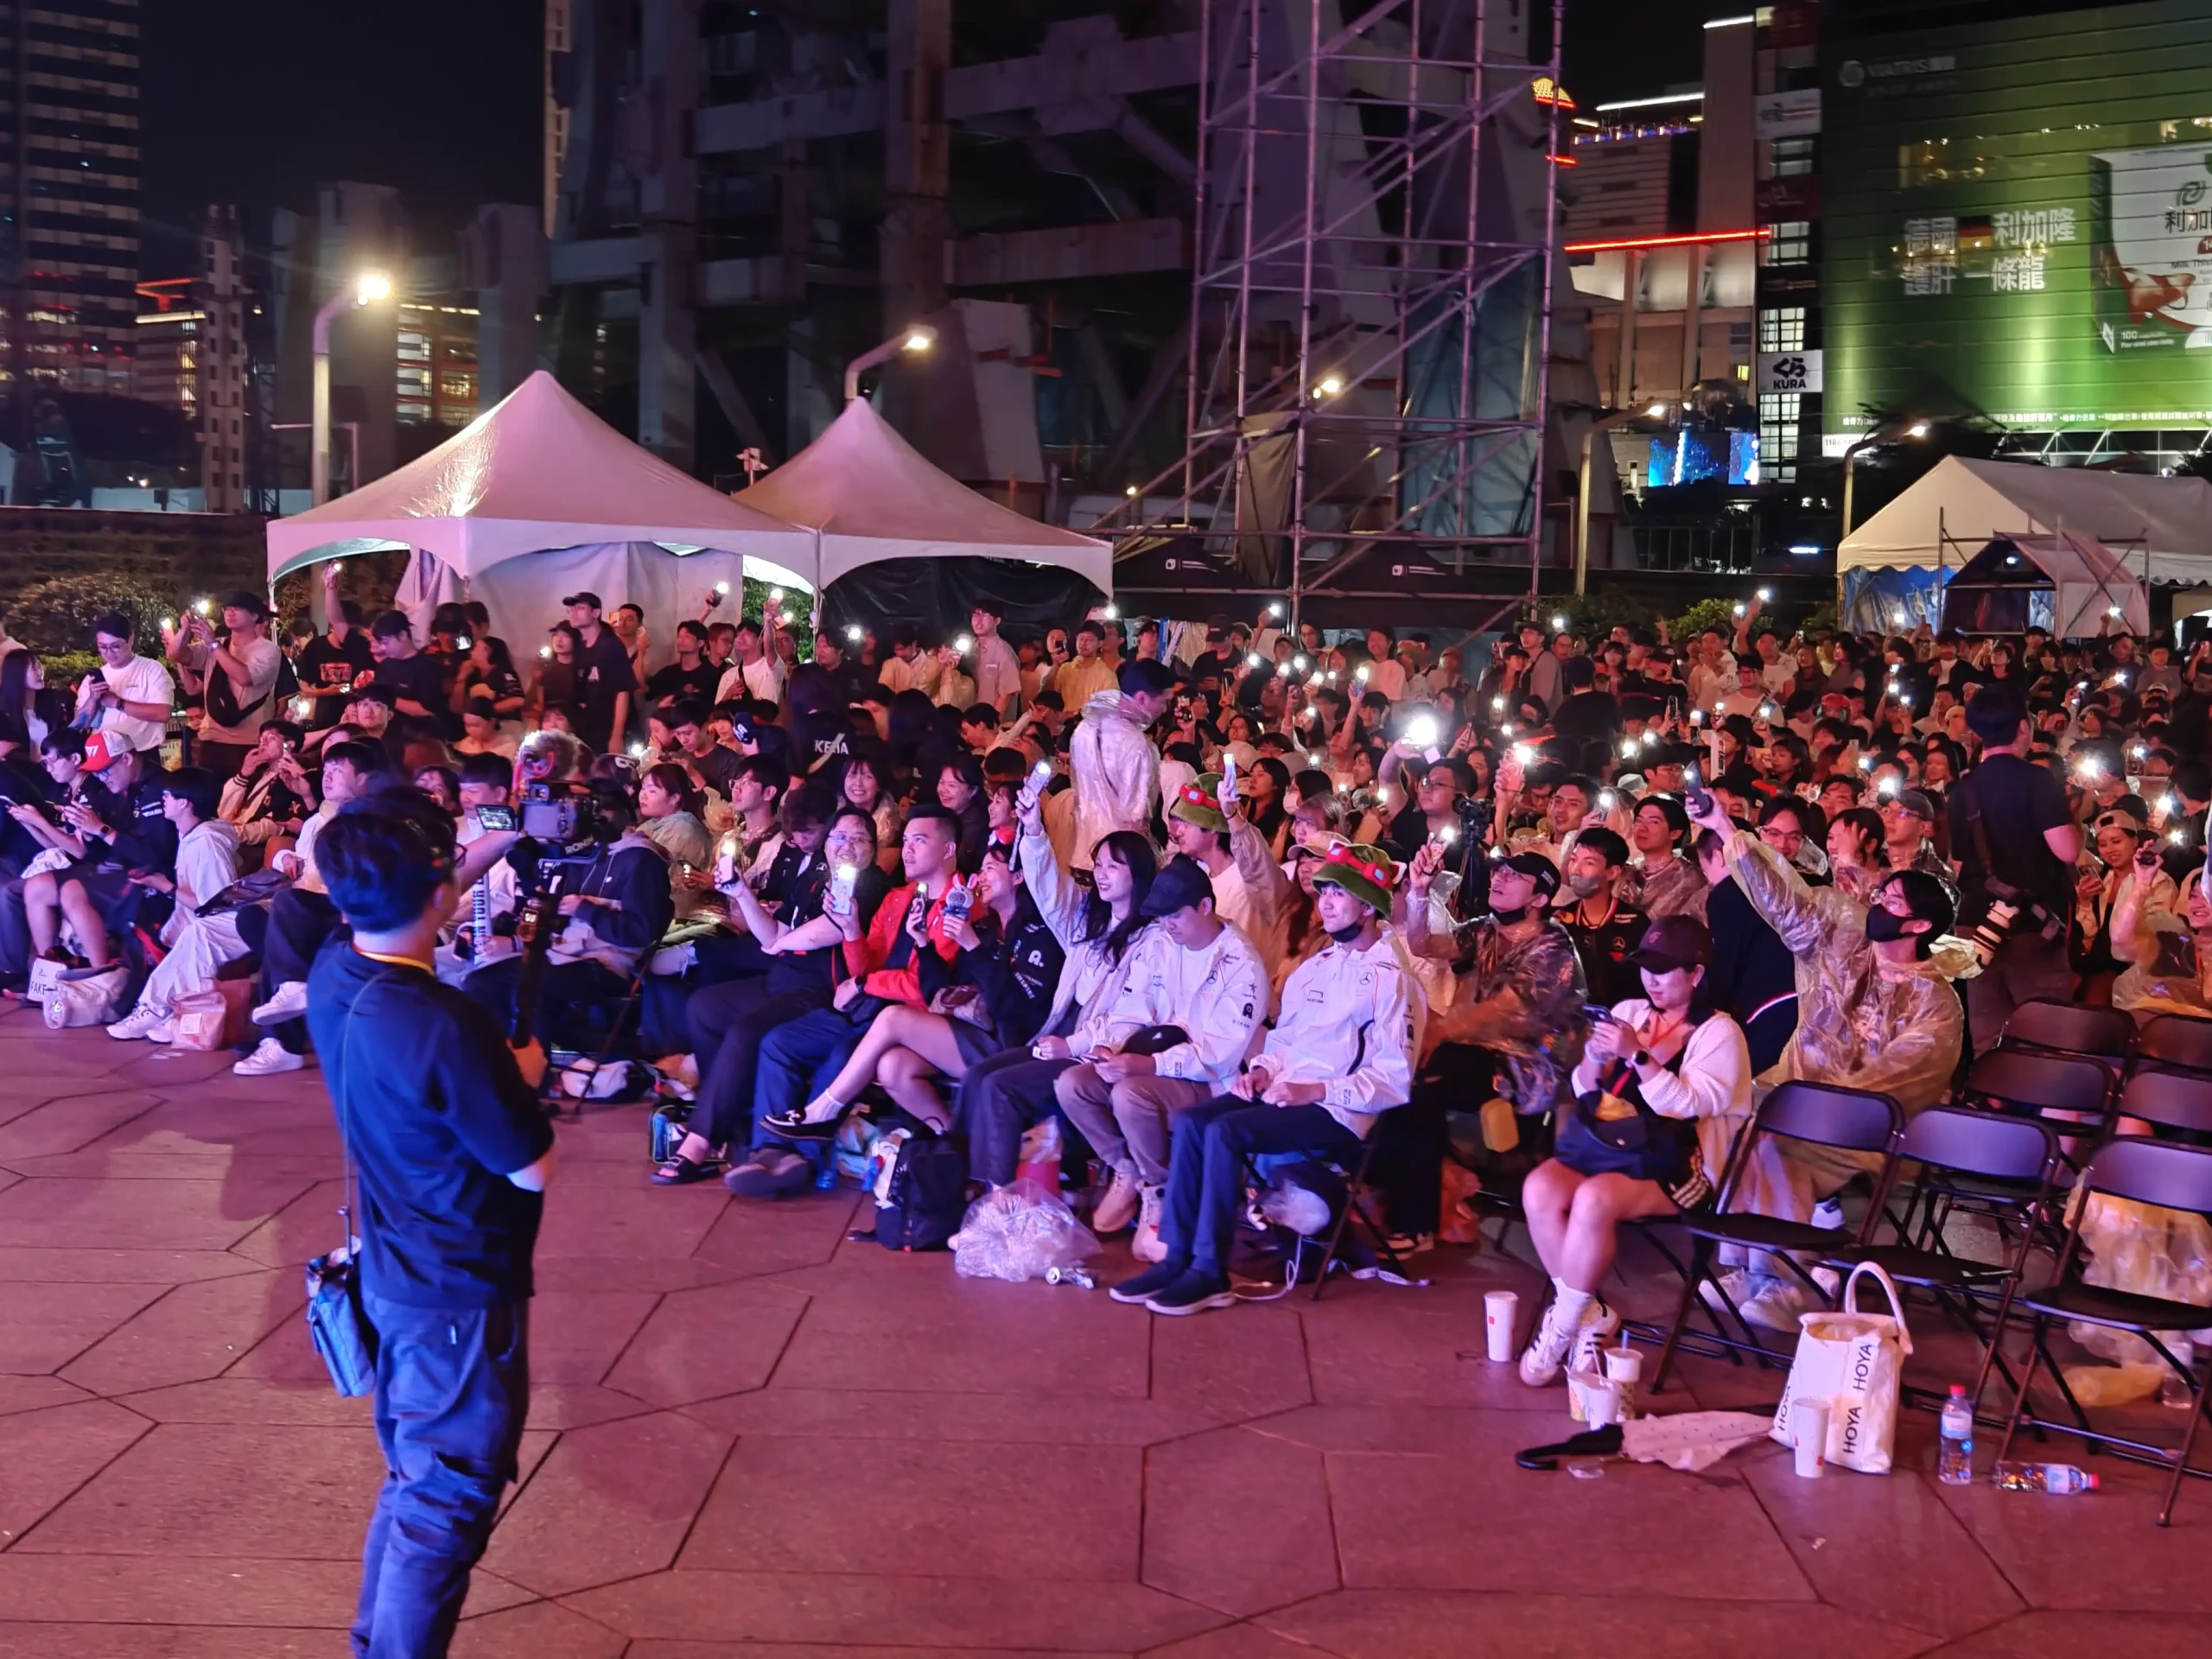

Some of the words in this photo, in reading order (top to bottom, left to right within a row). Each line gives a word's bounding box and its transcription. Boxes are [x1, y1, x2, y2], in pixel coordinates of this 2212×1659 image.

[1993, 207, 2076, 246] 利加隆
[2164, 207, 2212, 233] 利加
[1772, 357, 1806, 378] くら
[1773, 379, 1806, 390] KURA
[1853, 1344, 1873, 1391] HOYA
[1777, 1385, 1791, 1432] HOYA
[1843, 1406, 1862, 1454] HOYA
